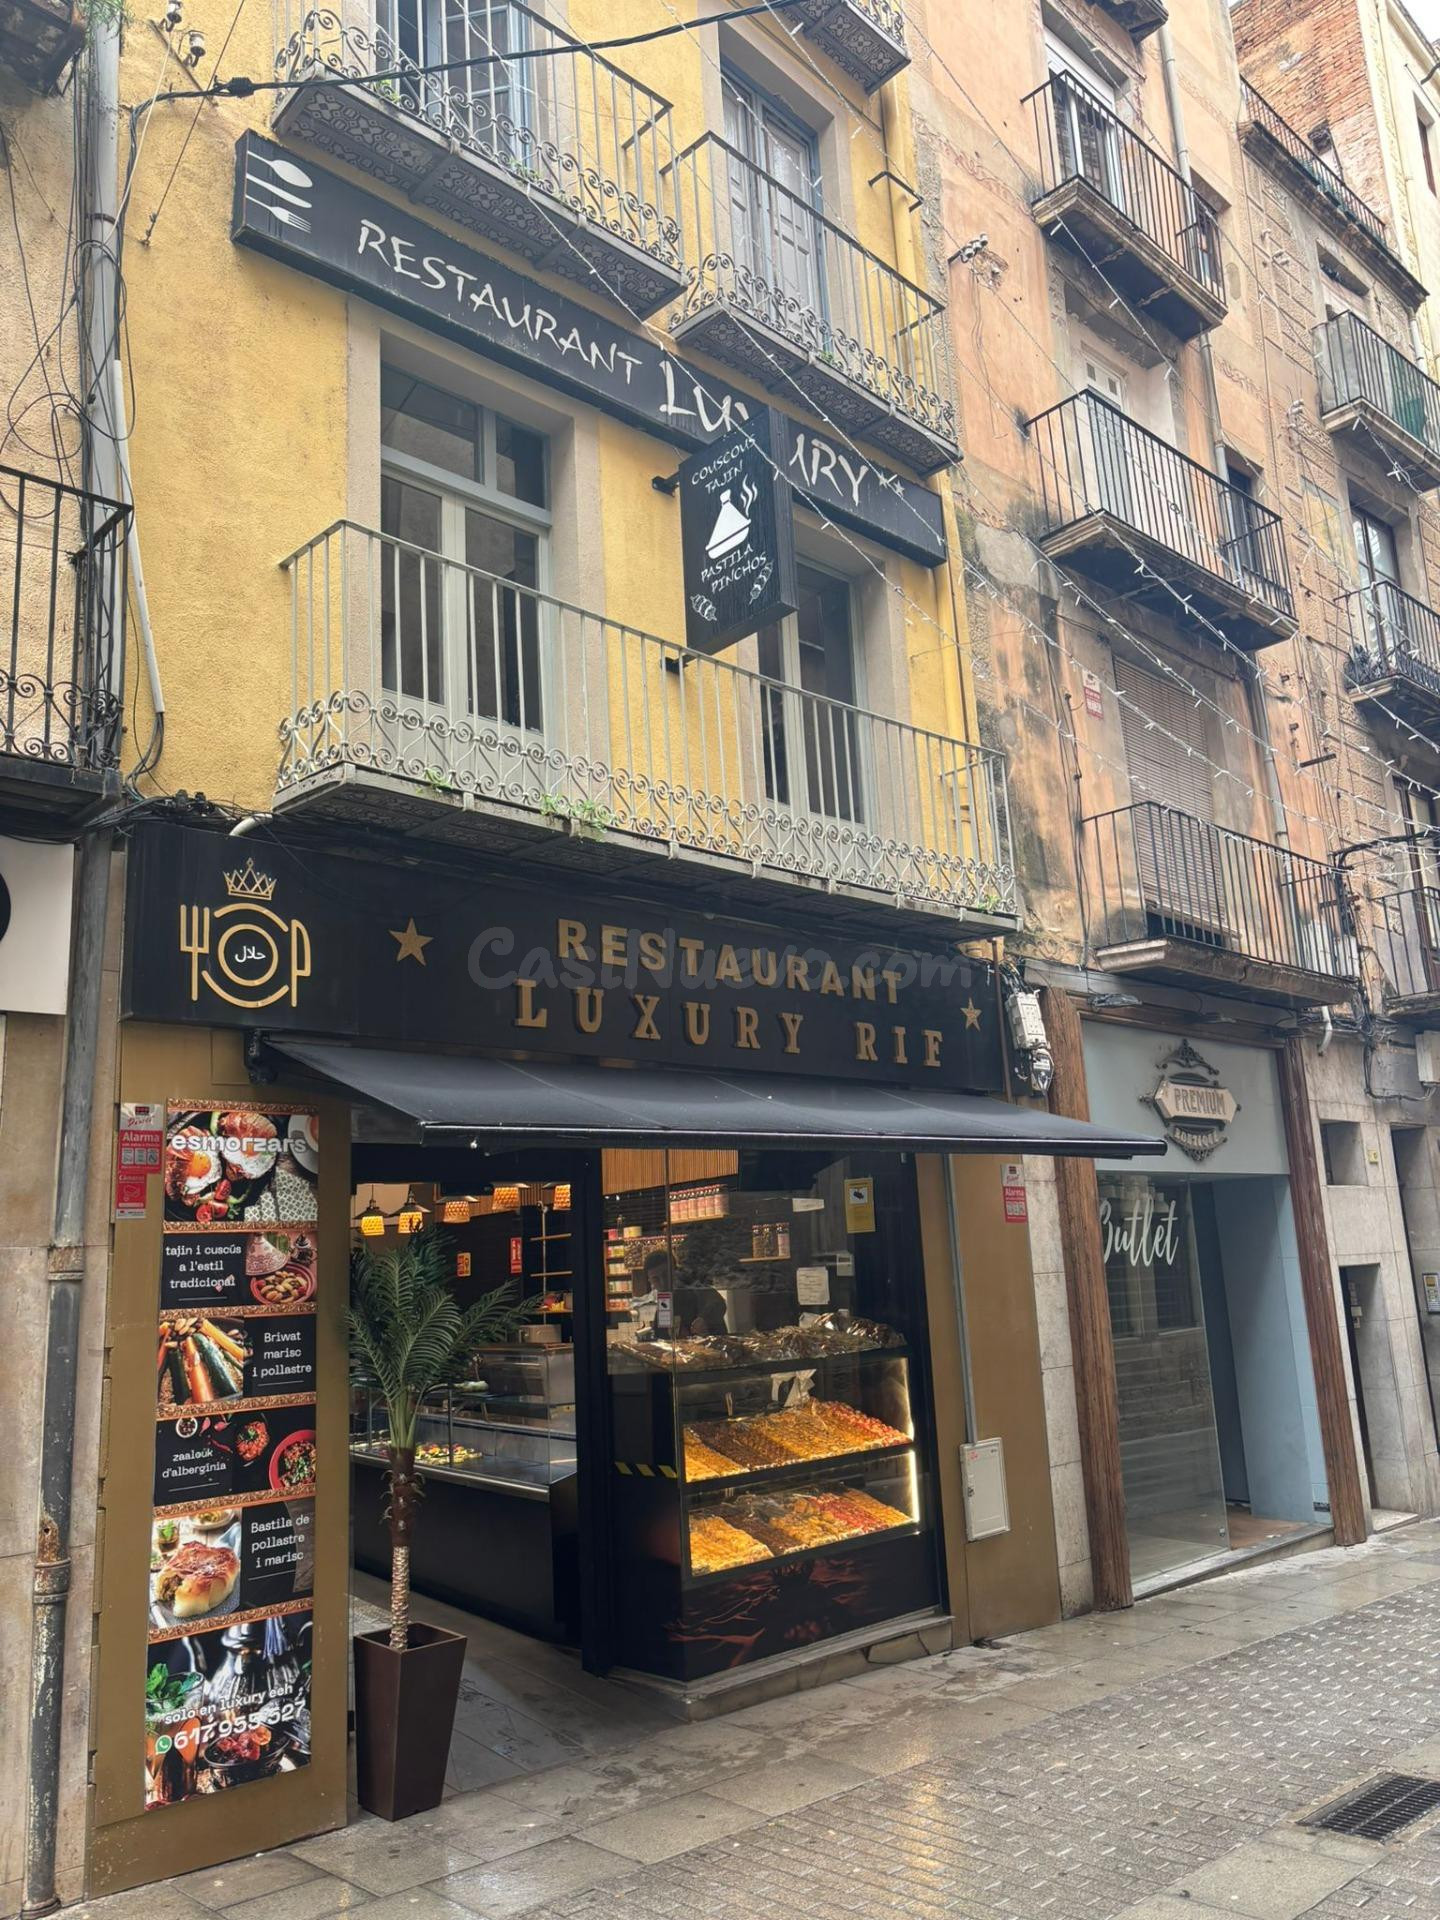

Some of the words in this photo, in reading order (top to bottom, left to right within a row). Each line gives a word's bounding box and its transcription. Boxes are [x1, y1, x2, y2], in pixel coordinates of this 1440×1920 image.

[357, 219, 643, 385] RESTAURANT
[658, 361, 869, 507] LURY
[691, 433, 755, 485] COUSCOUS
[705, 459, 743, 494] TAJIN
[701, 544, 753, 583] PASTILA
[711, 551, 767, 594] PINCHOS
[234, 945, 266, 963] حلال
[556, 918, 902, 1004] RESTAURANT
[513, 977, 804, 1054] LUXURY
[1173, 1088, 1227, 1115] PREMIUM
[122, 1132, 160, 1142] Alarma
[171, 1134, 307, 1152] esmorzars
[195, 1245, 201, 1255] i
[204, 1244, 242, 1255] cuscús
[179, 1264, 187, 1272] a
[189, 1260, 224, 1272] l'estil
[169, 1277, 236, 1289] tradicional
[264, 1331, 302, 1343] Briwat
[264, 1347, 302, 1359] marisc
[252, 1366, 258, 1377] i
[260, 1364, 312, 1379] pollastre
[251, 1517, 293, 1533] Bastila
[295, 1514, 310, 1526] de
[251, 1534, 305, 1554] pollastre
[256, 1557, 262, 1568] i
[264, 1551, 304, 1567] marisc
[164, 1709, 196, 1725] solo
[200, 1703, 216, 1716] en
[219, 1690, 267, 1710] luxury
